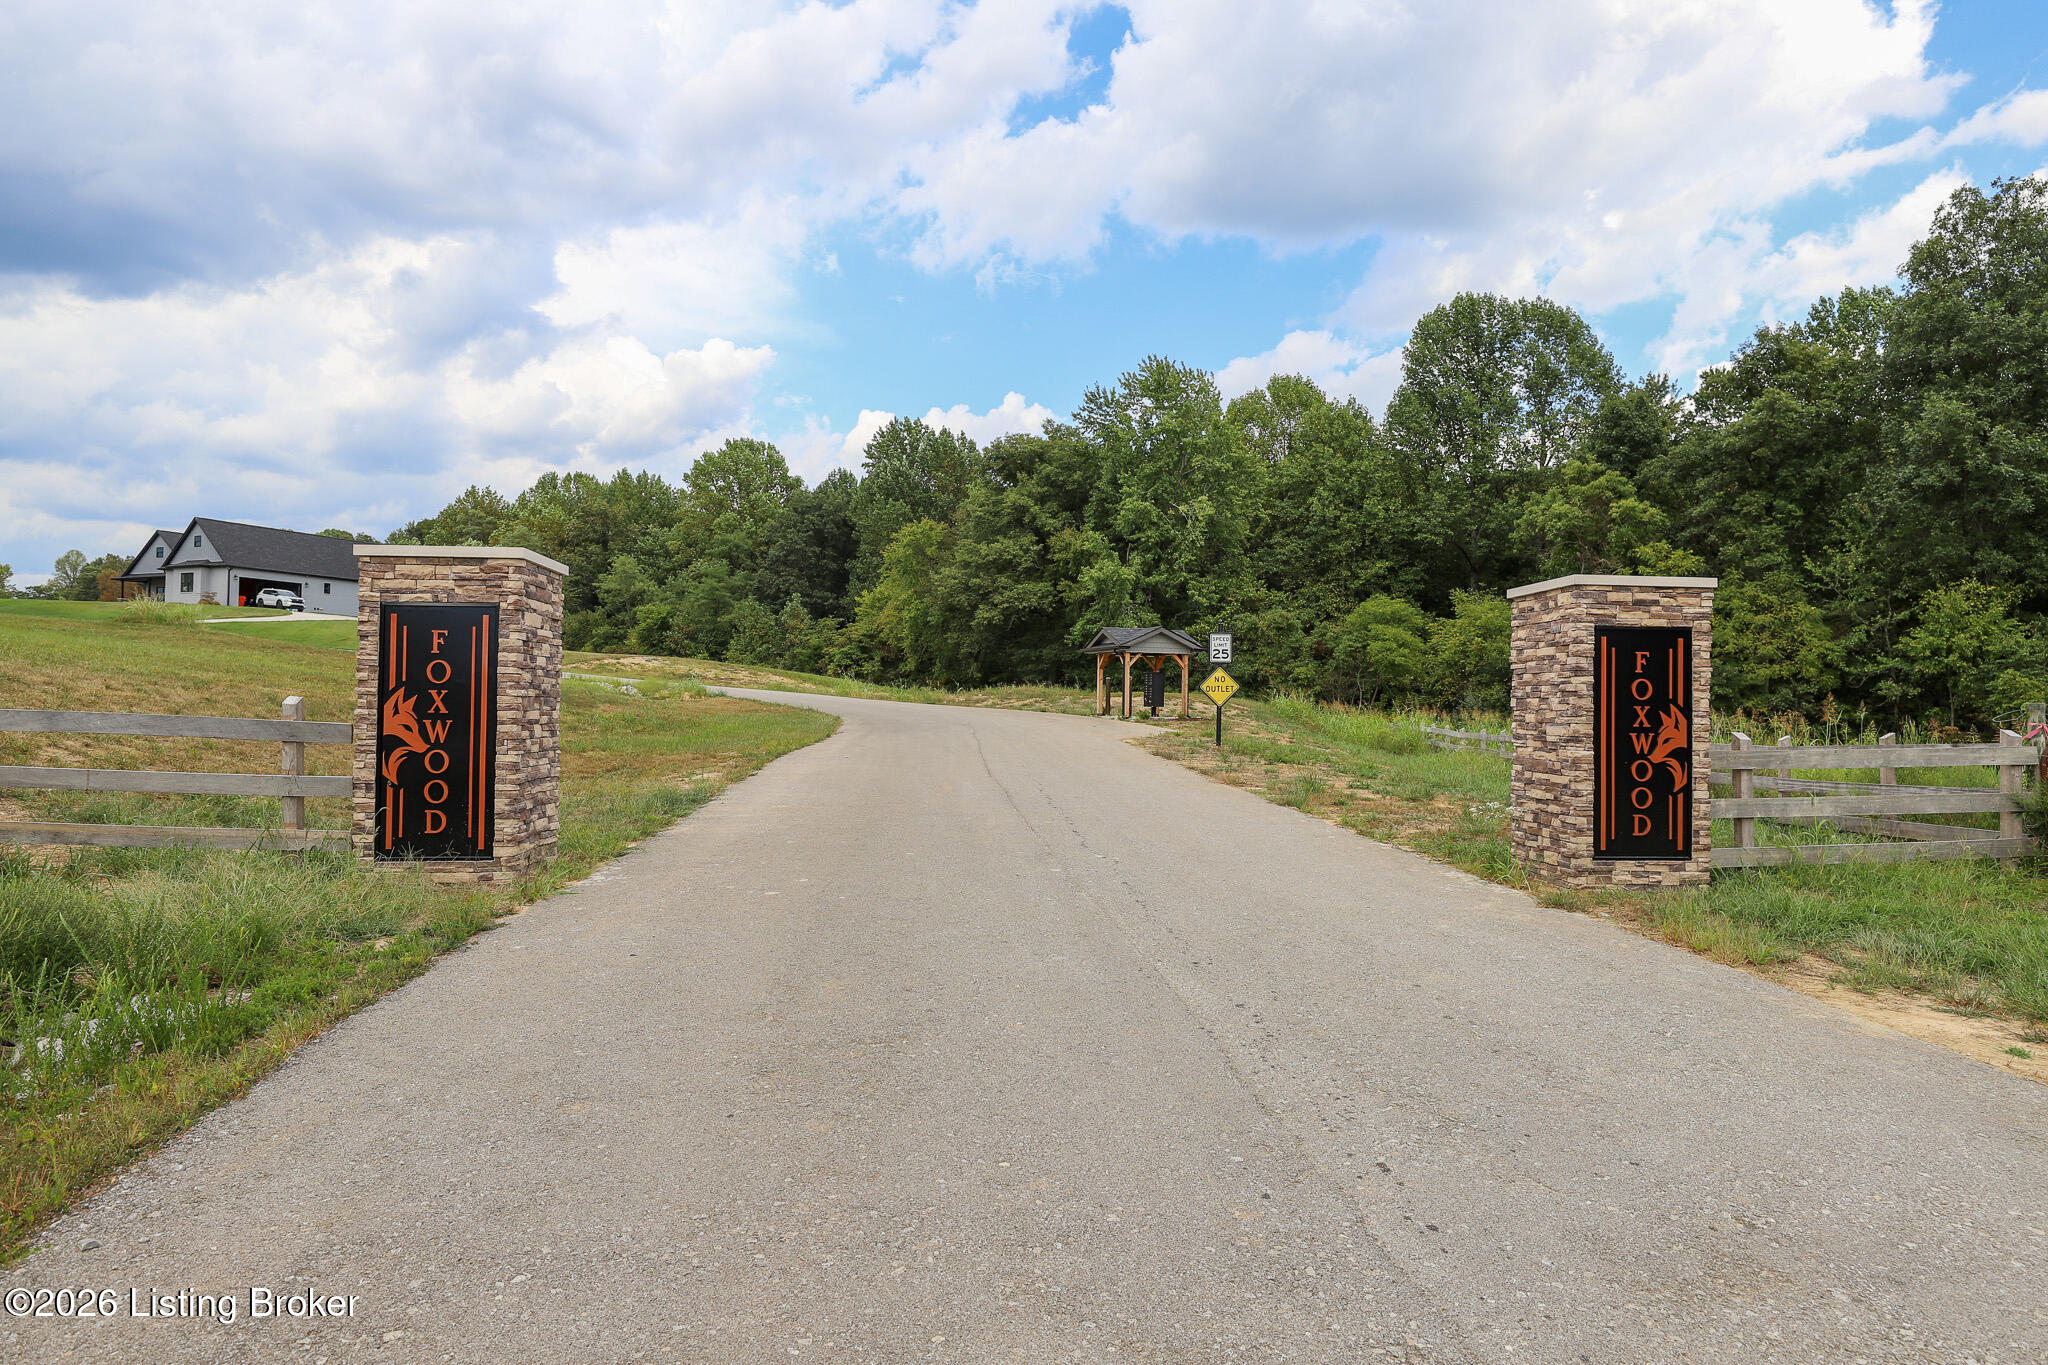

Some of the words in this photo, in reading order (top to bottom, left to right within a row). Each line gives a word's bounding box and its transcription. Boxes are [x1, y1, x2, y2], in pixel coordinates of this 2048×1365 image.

[1205, 685, 1235, 693] OUTLET
[1212, 648, 1230, 659] 25
[423, 630, 453, 834] FOXWOOD
[1629, 651, 1655, 836] FOXWOOD
